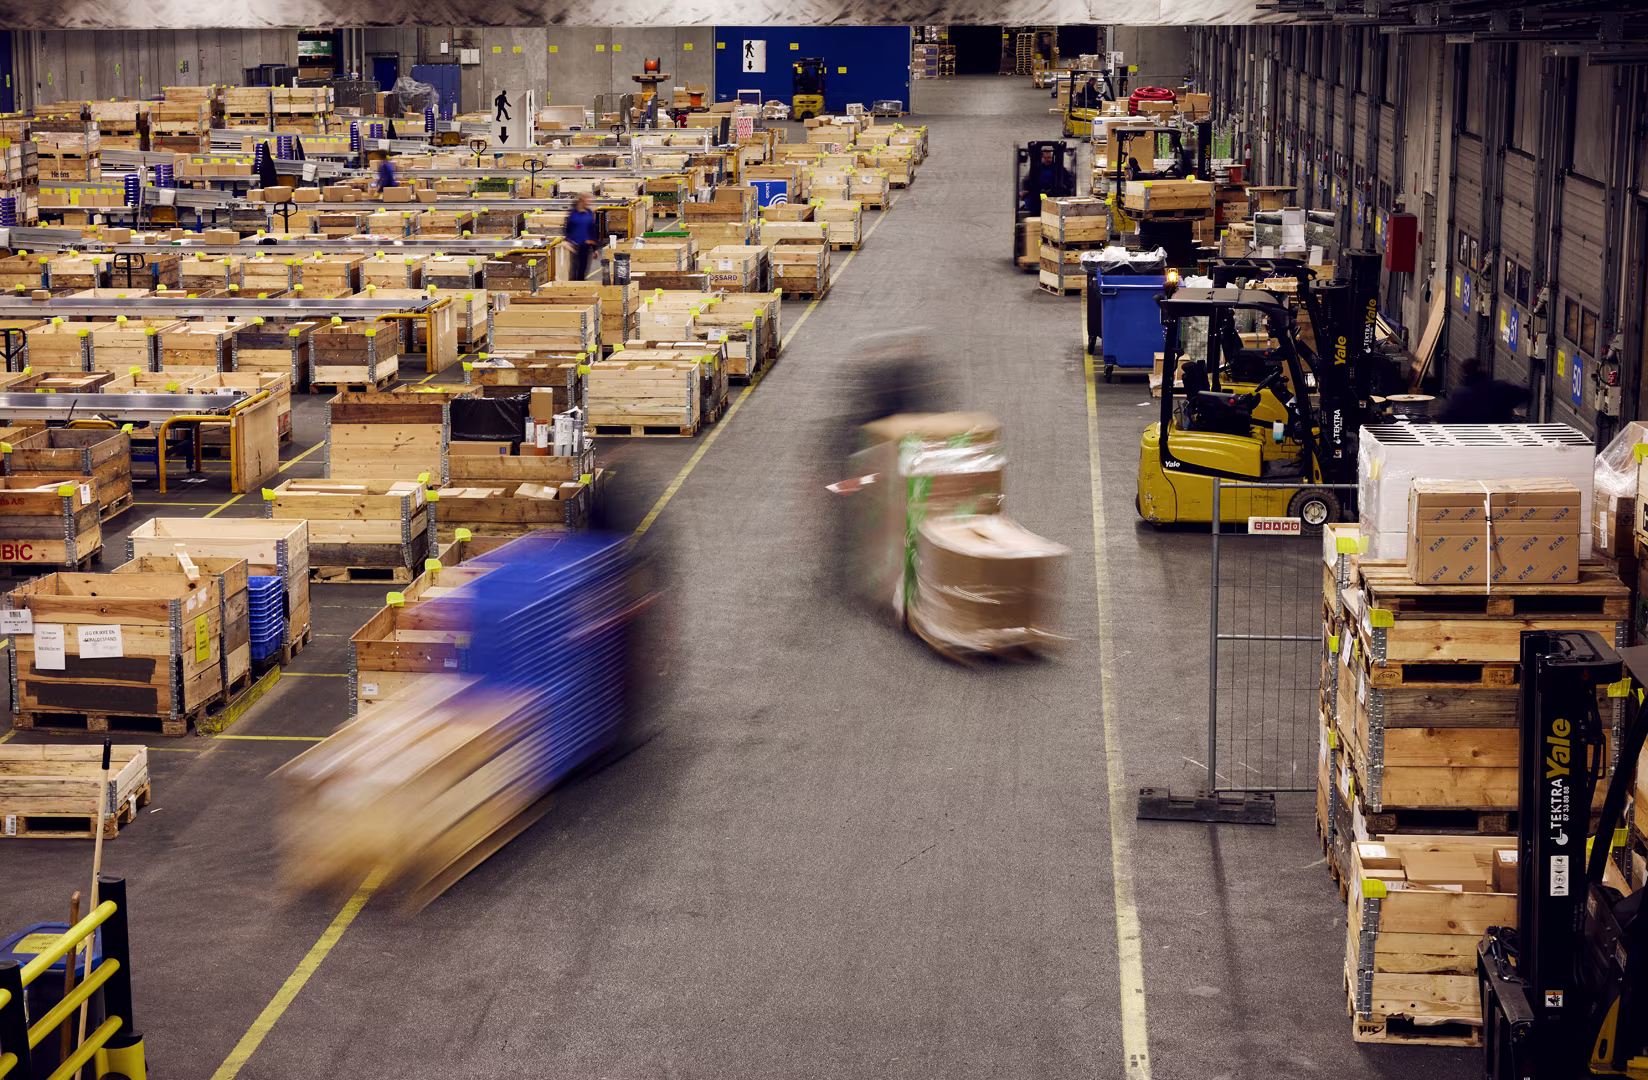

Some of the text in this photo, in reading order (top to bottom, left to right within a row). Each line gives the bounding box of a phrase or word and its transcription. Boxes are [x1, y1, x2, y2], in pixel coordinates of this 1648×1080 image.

[1365, 298, 1376, 324] Yale
[1511, 316, 1518, 344] 51
[1334, 335, 1347, 365] Yale
[1573, 364, 1582, 397] 50
[1333, 409, 1341, 438] TEKTRA
[1165, 460, 1181, 468] Yale
[1254, 522, 1299, 530] CRAMO
[0, 544, 33, 560] BIC
[1546, 718, 1571, 778] Yale
[1550, 778, 1563, 829] TEKTRA
[1563, 804, 1569, 812] 33
